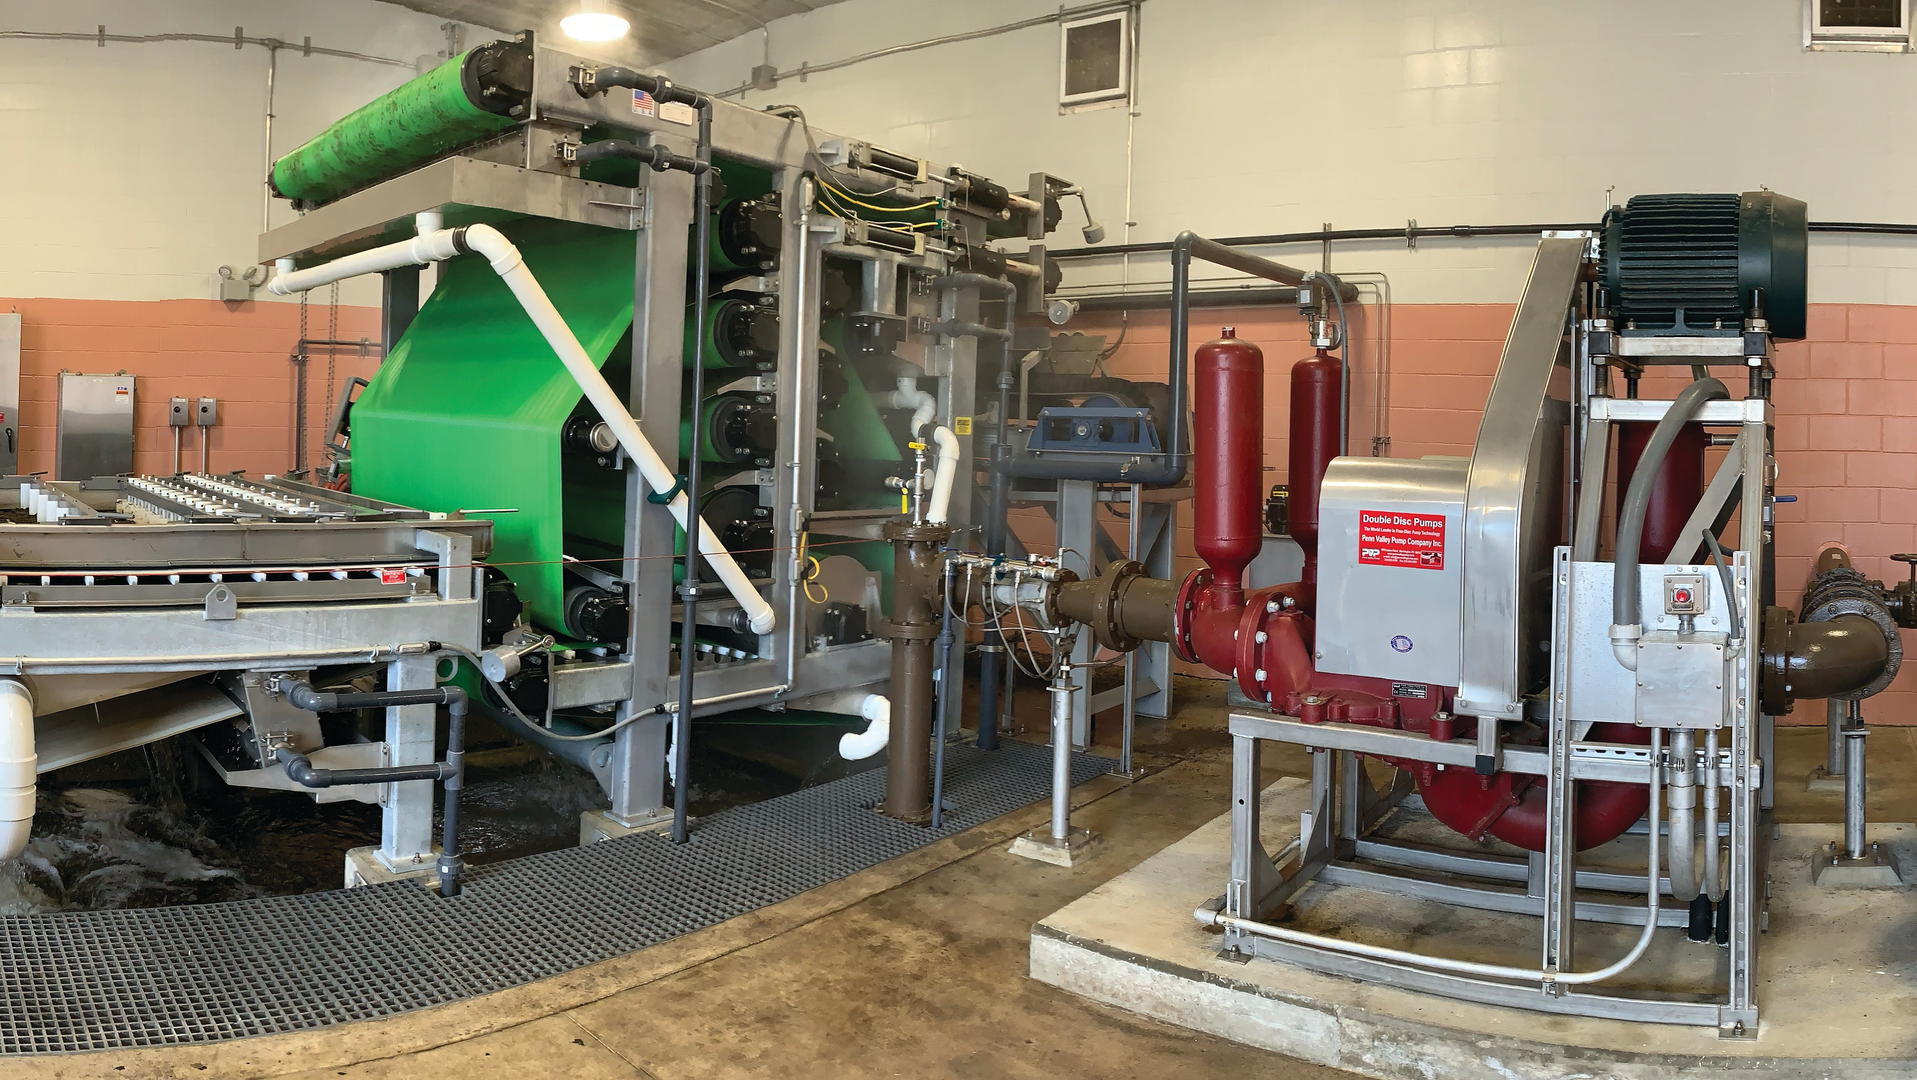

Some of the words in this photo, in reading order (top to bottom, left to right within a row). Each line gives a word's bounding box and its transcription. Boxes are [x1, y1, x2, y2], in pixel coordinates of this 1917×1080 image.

[1362, 514, 1392, 524] Double
[1393, 516, 1412, 526] Disc
[1413, 517, 1443, 529] Pumps
[1361, 534, 1375, 542] Penn
[1375, 535, 1391, 545] Valley
[1391, 536, 1407, 546] Pump
[1407, 537, 1432, 548] Company
[1432, 539, 1443, 548] Inc.
